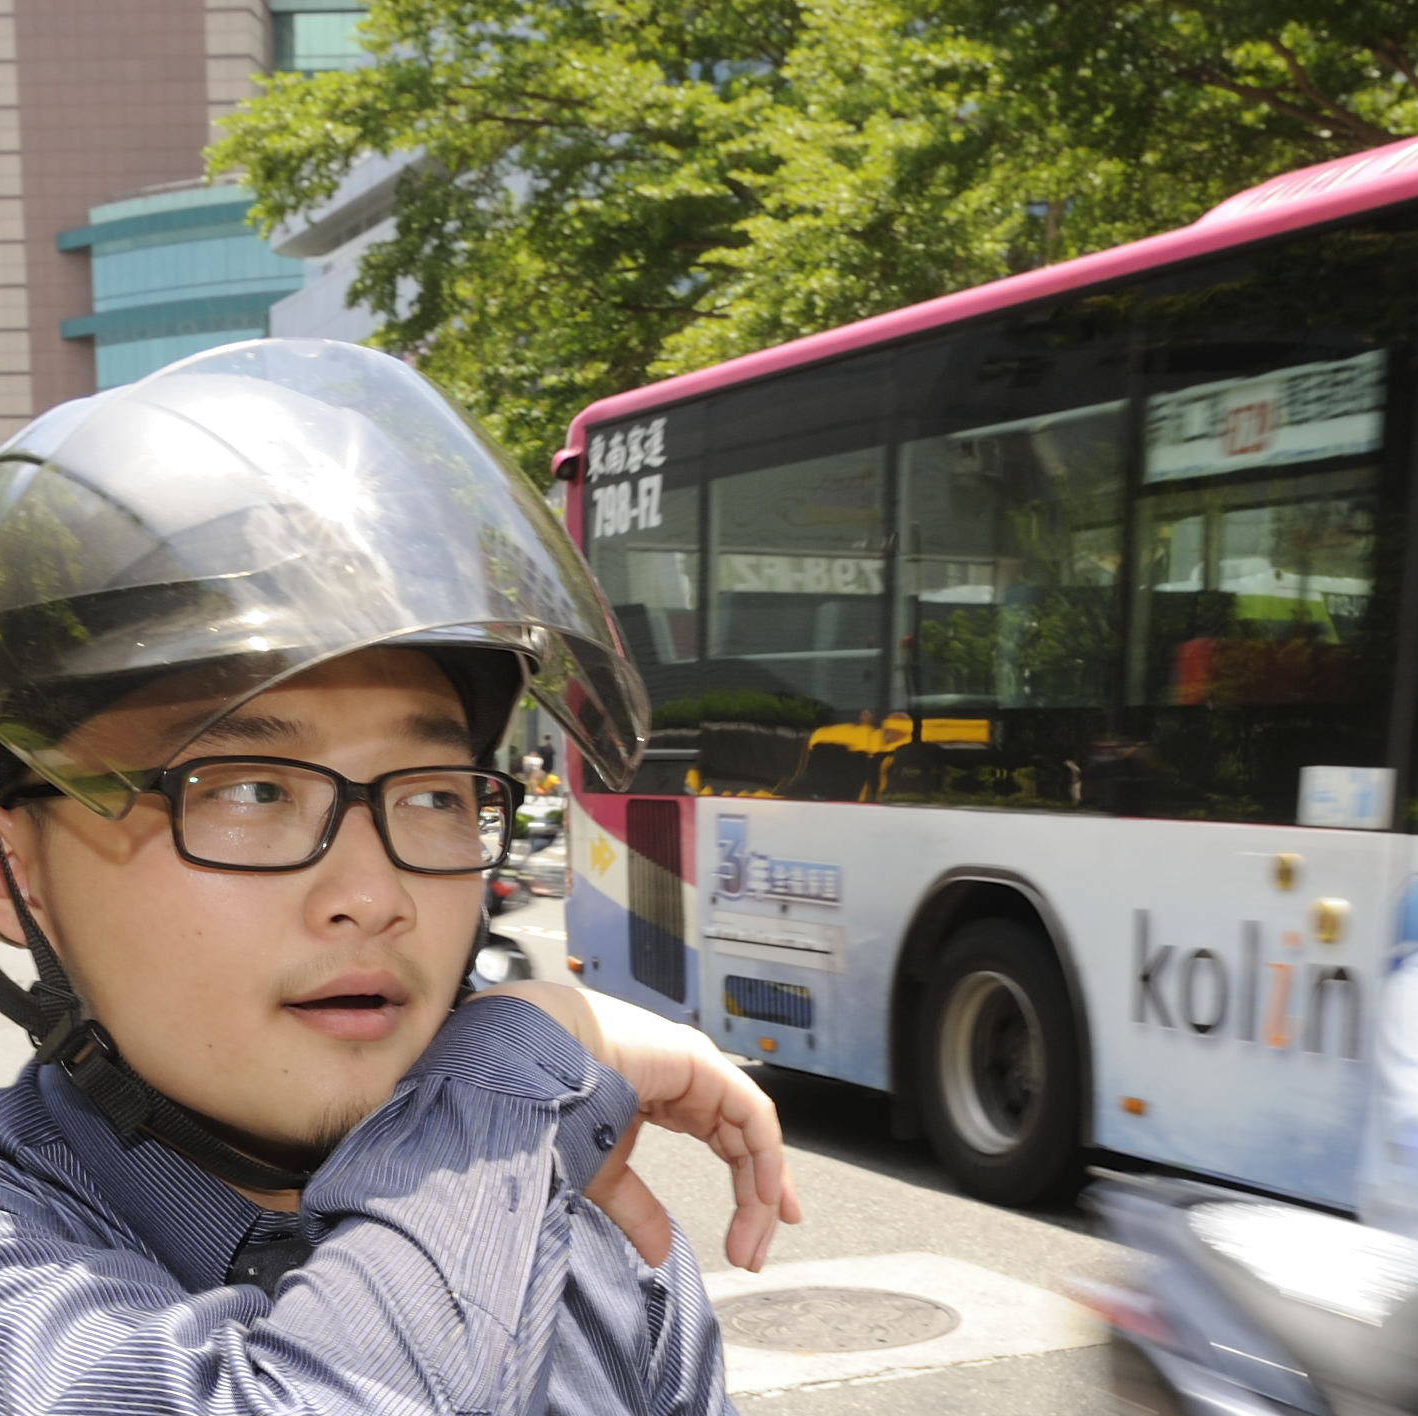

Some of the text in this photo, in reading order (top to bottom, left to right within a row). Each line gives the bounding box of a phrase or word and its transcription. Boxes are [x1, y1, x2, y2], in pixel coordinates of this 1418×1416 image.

[586, 417, 668, 483] 東南客運
[592, 474, 663, 538] 798-FZ
[1130, 908, 1365, 1062] kolin
